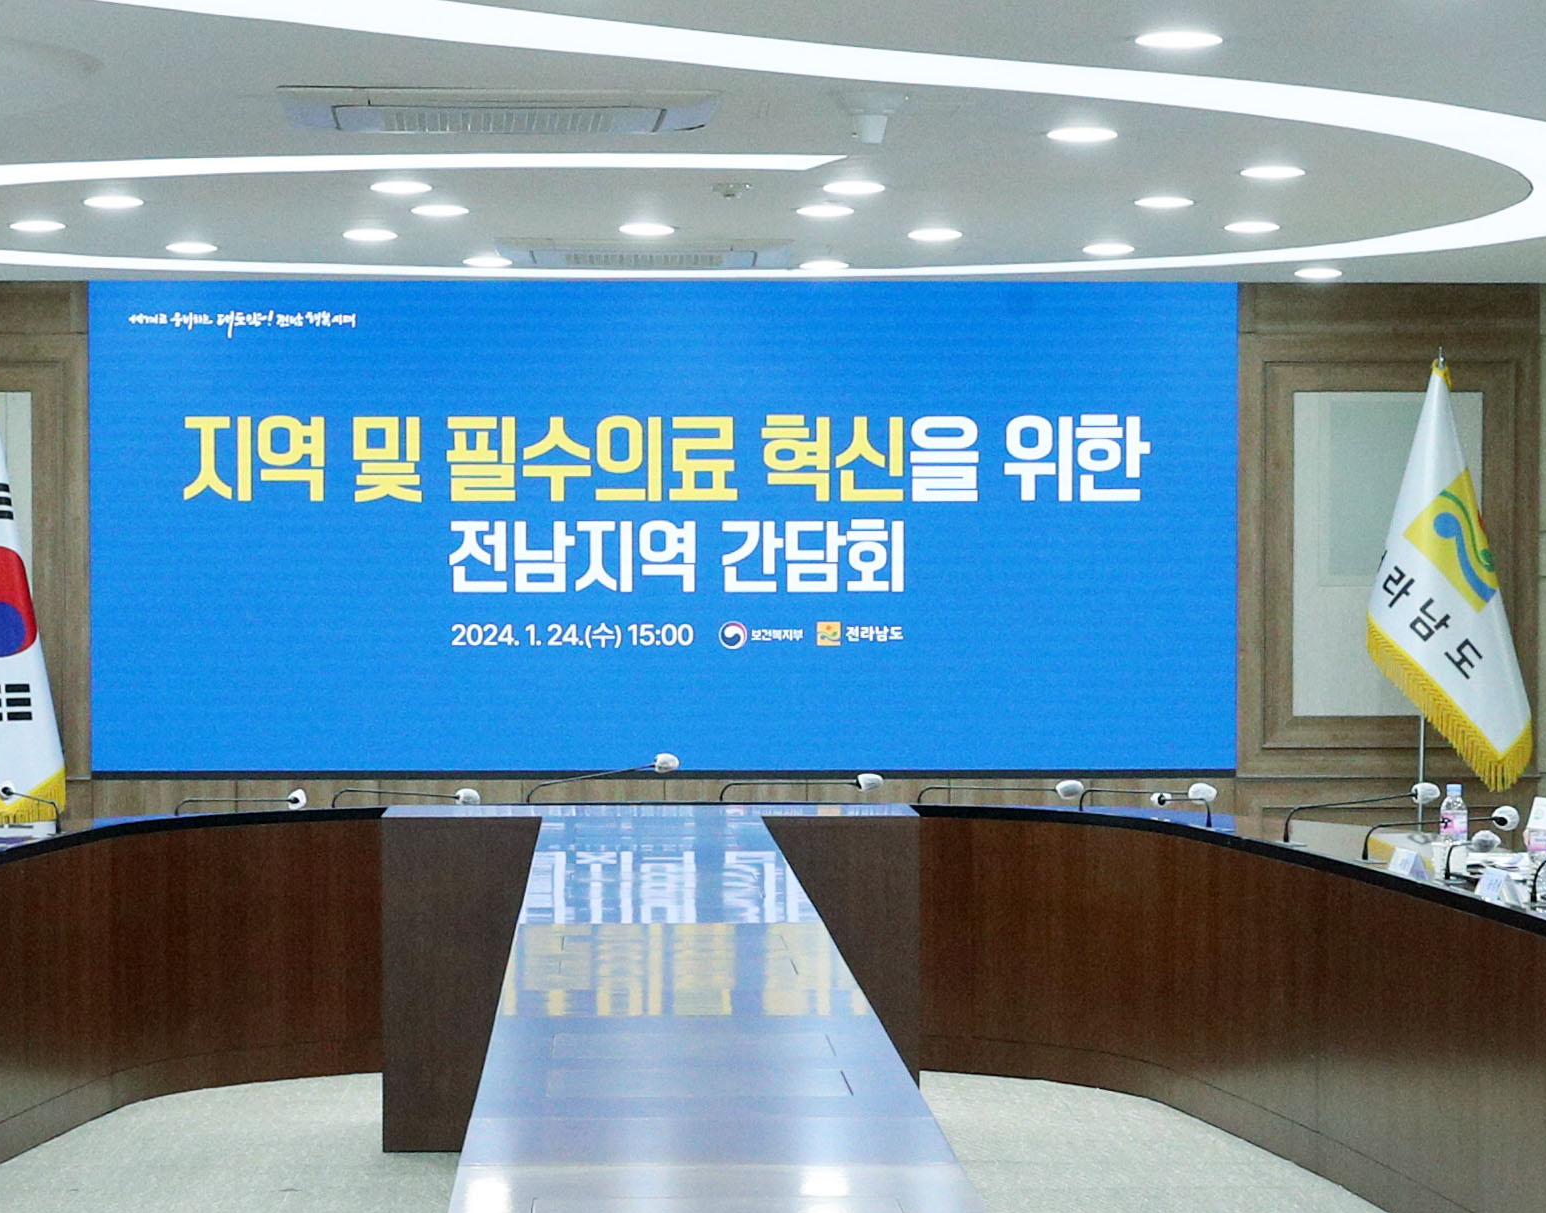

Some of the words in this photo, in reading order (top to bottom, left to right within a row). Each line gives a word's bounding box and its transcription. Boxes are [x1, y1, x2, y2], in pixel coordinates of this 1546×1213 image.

[182, 414, 325, 502] 지역
[352, 416, 423, 503] 및
[446, 414, 739, 502] 필수의료
[760, 413, 980, 503] 혁신을
[1003, 413, 1151, 502] 위한
[448, 519, 697, 593] 전남지역
[721, 518, 905, 593] 간담회
[451, 623, 520, 647] 2024.
[525, 623, 542, 646] 1.
[547, 622, 622, 649] 24.(수)
[627, 623, 694, 647] 15:00
[751, 626, 804, 643] 보건복지부
[845, 625, 904, 643] 전라남도
[1378, 549, 1483, 680] 라남도
